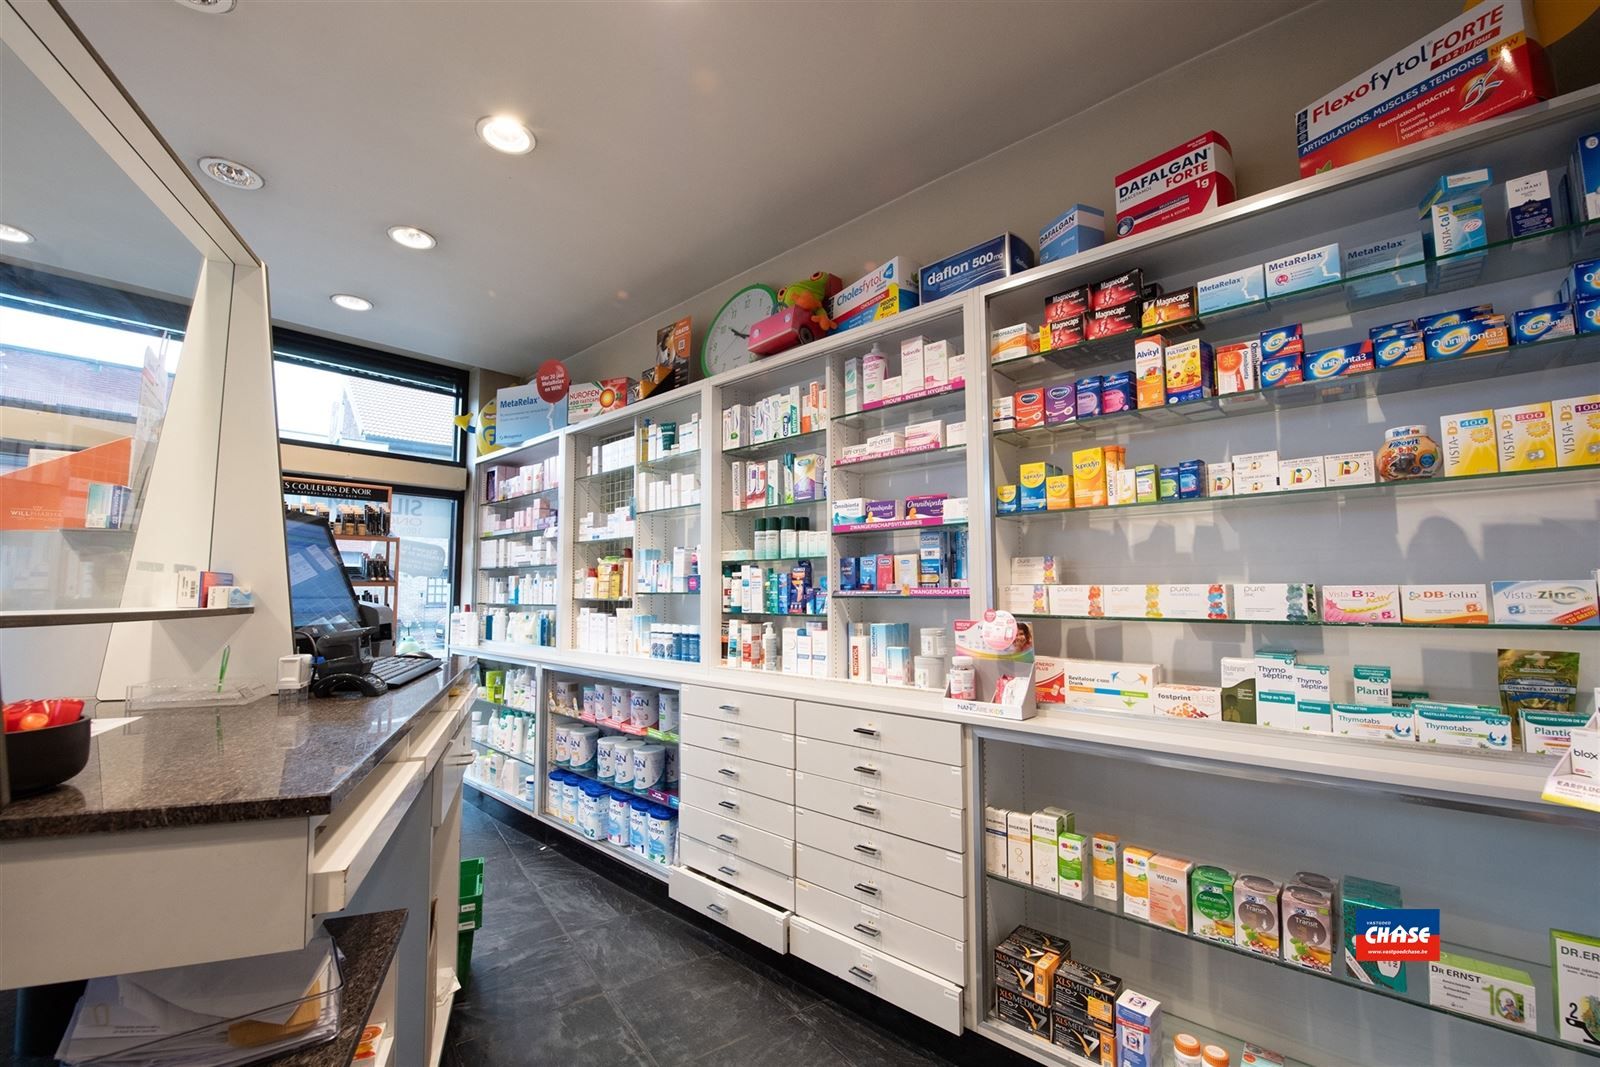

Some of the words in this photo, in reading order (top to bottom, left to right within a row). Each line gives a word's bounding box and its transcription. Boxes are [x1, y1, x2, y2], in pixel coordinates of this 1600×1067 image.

[1312, 46, 1428, 124] Flexofytol
[1432, 4, 1504, 57] FORTE
[1373, 88, 1418, 118] MUSCLES
[1420, 83, 1428, 92] &
[1430, 55, 1484, 86] TENDONS
[1378, 105, 1415, 129] Formulation
[1416, 85, 1456, 112] BIOACTIVE
[1119, 148, 1208, 199] DAFALGAN
[1166, 161, 1209, 188] FORTE
[1195, 178, 1210, 189] 1g
[1515, 182, 1543, 194] MINAMI
[1040, 215, 1075, 244] DAFALGAN
[1347, 240, 1403, 260] MetaRelax
[1268, 251, 1322, 271] MetaRelax
[928, 262, 968, 286] daflon
[1101, 275, 1129, 289] Magnecaps
[1200, 277, 1241, 293] MetaRelax
[837, 271, 882, 306] Cholesfytol
[880, 296, 897, 309] PROMO
[1156, 292, 1190, 307] Magnecaps
[882, 302, 895, 311] PACK
[1095, 306, 1126, 319] Magnecaps
[1052, 318, 1080, 331] Magnecaps
[1432, 329, 1504, 348] Omnibionta3
[1137, 347, 1160, 360] Alvityl
[1310, 353, 1367, 371] Omnibionta3
[570, 389, 600, 400] NUROFEN
[905, 390, 927, 401] INTIEME
[500, 397, 538, 409] MetaRelax
[1516, 411, 1543, 421] 800
[1461, 419, 1486, 428] 400
[1075, 460, 1100, 470] Supradyn
[292, 483, 338, 493] COULEURS
[351, 488, 371, 496] NOIR
[850, 520, 923, 531] ZWANGERSCHAPSVITAMINES
[1170, 586, 1190, 594] pure
[1243, 586, 1265, 595] pure
[1423, 591, 1477, 600] DB-folin
[1503, 590, 1576, 600] Vista-Zinc
[1257, 665, 1286, 674] Thymo
[1297, 677, 1322, 685] Thymo
[1157, 692, 1191, 702] fostprint
[1356, 686, 1389, 696] Plantil
[1338, 715, 1380, 724] Thymotabs
[1425, 722, 1473, 733] Thymotabs
[1573, 749, 1598, 760] blox
[660, 855, 666, 864] 2
[1157, 873, 1178, 884] WELEDA
[1245, 904, 1268, 915] Transit
[1295, 916, 1318, 928] Transit
[1446, 969, 1482, 984] ERNST
[1569, 1002, 1578, 1019] 2
